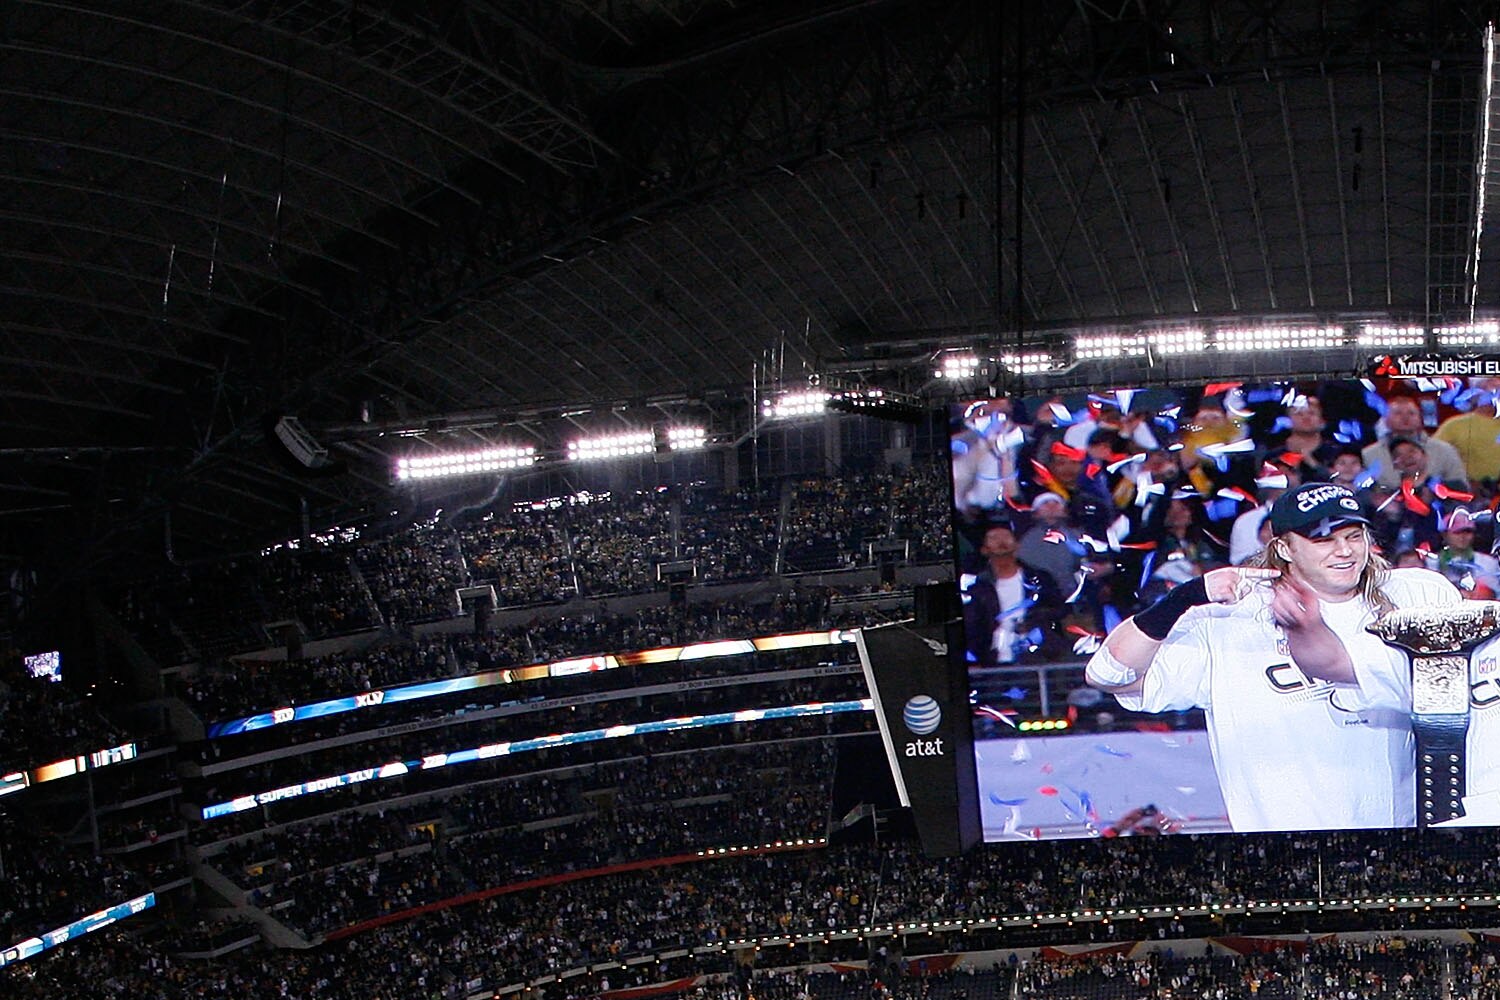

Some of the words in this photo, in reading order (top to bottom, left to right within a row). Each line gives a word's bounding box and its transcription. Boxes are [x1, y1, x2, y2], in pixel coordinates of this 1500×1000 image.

[1400, 361, 1481, 375] MITSUBISHI
[355, 690, 385, 707] XLV
[905, 738, 944, 757] at&t
[258, 785, 303, 804] SUPER
[307, 777, 346, 793] BOWL
[349, 768, 374, 784] XLV
